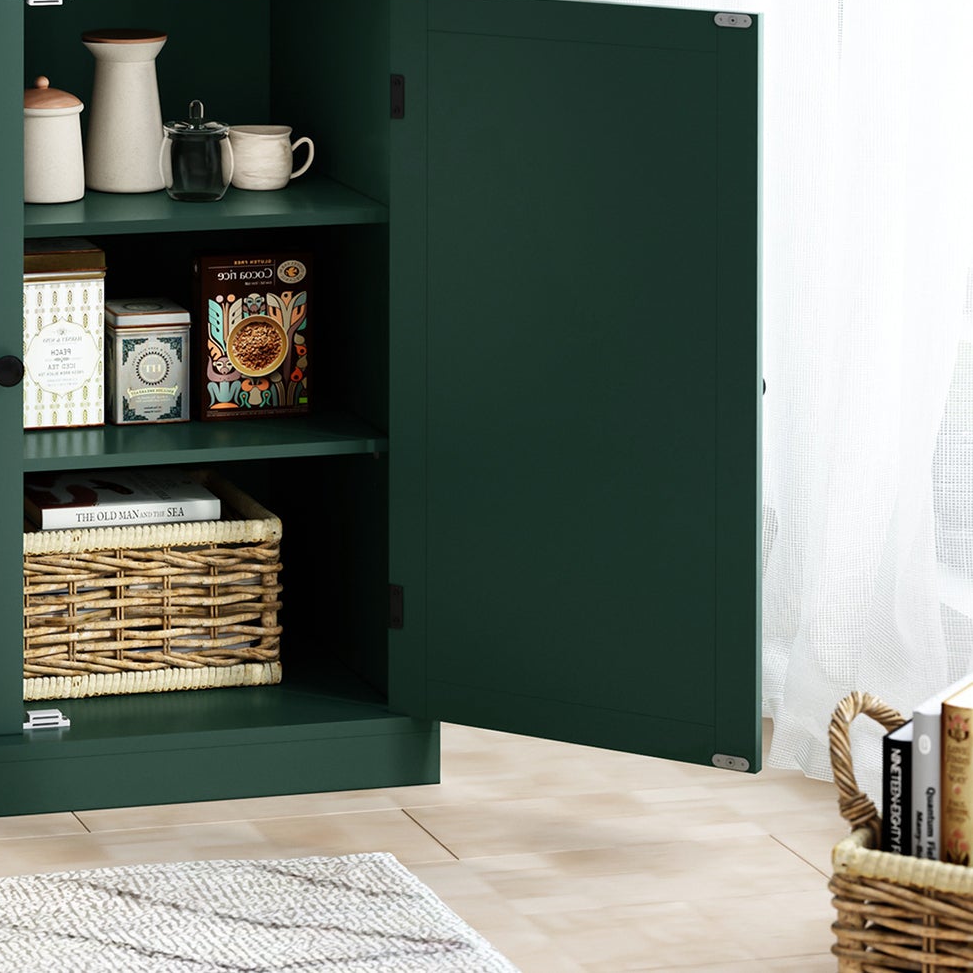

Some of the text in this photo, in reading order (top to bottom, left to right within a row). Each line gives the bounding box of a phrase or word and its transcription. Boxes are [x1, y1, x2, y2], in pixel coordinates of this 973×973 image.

[76, 513, 97, 522] THE
[96, 511, 118, 521] OLD
[119, 509, 139, 520] MAN
[166, 507, 185, 517] SEA
[926, 787, 936, 837] Quantum
